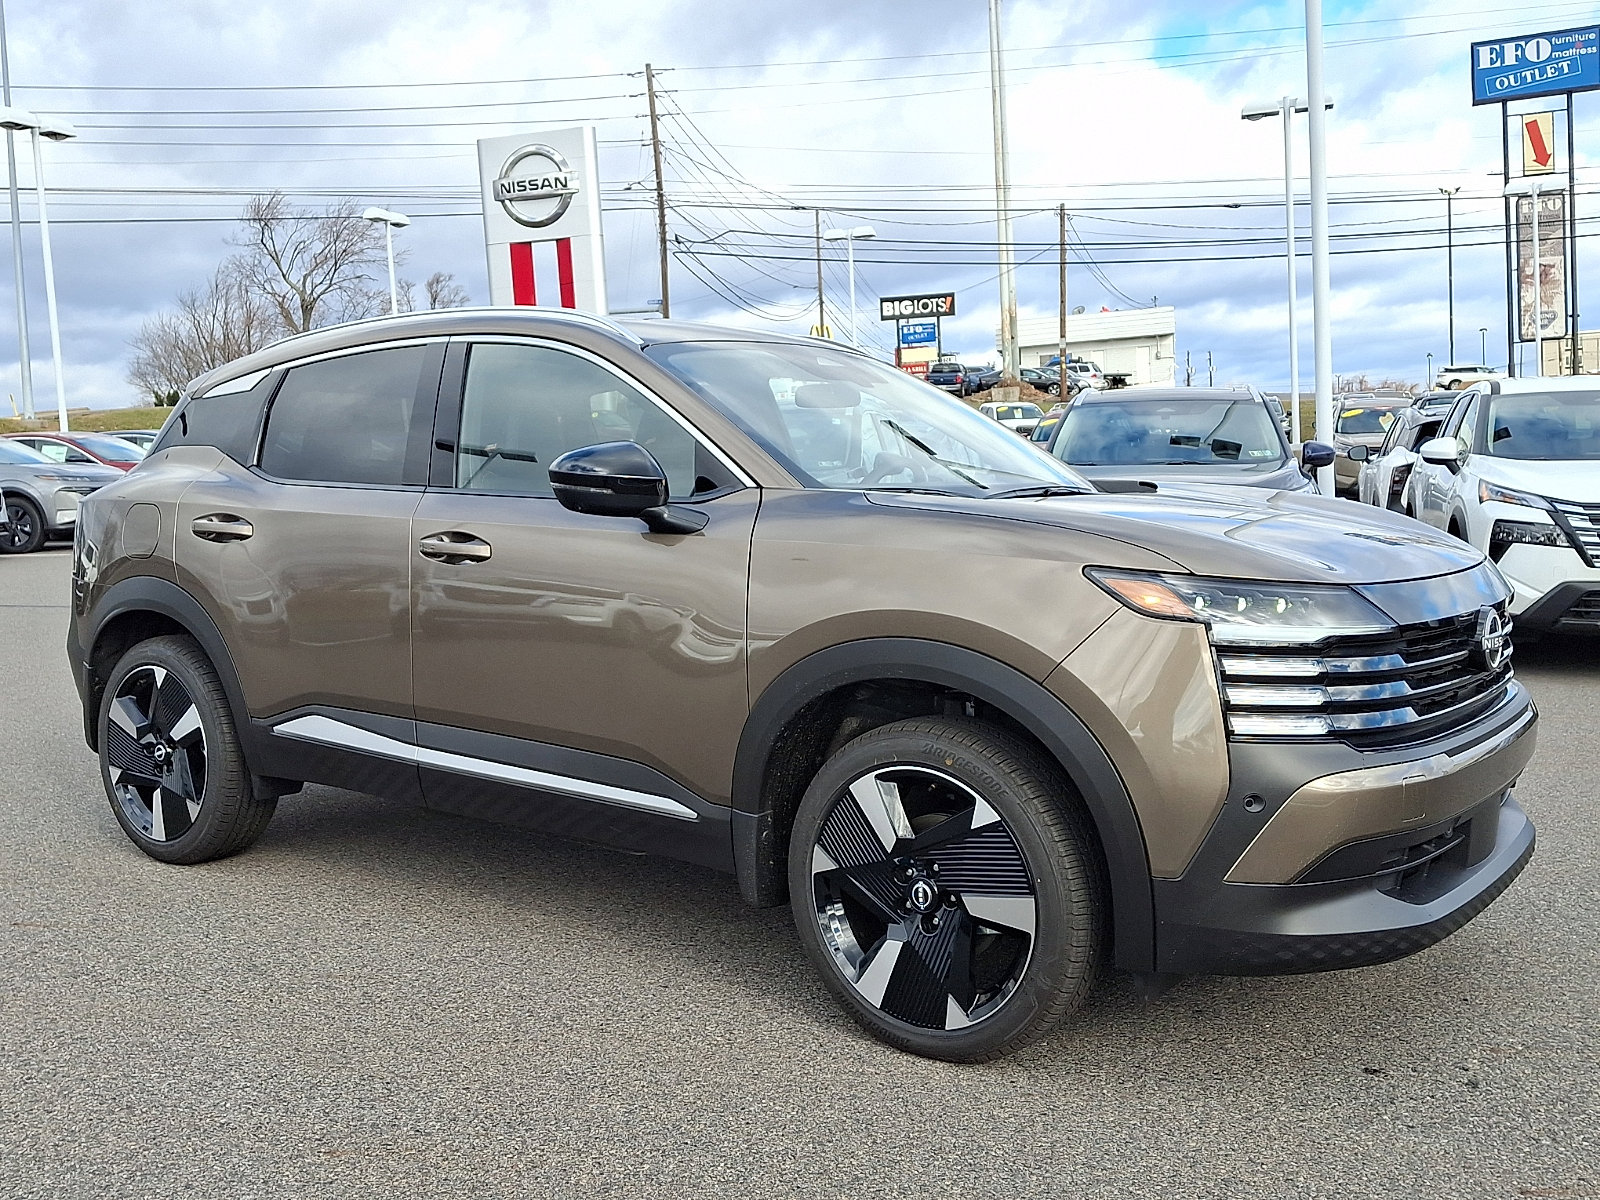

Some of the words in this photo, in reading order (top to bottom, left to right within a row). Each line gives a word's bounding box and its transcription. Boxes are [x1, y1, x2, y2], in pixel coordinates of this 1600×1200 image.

[1552, 32, 1596, 45] furniture
[1476, 38, 1552, 69] EFO
[1552, 46, 1597, 59] mattress
[1495, 60, 1571, 90] OUTLET
[500, 176, 568, 194] NISSAN
[903, 325, 923, 333] EFO
